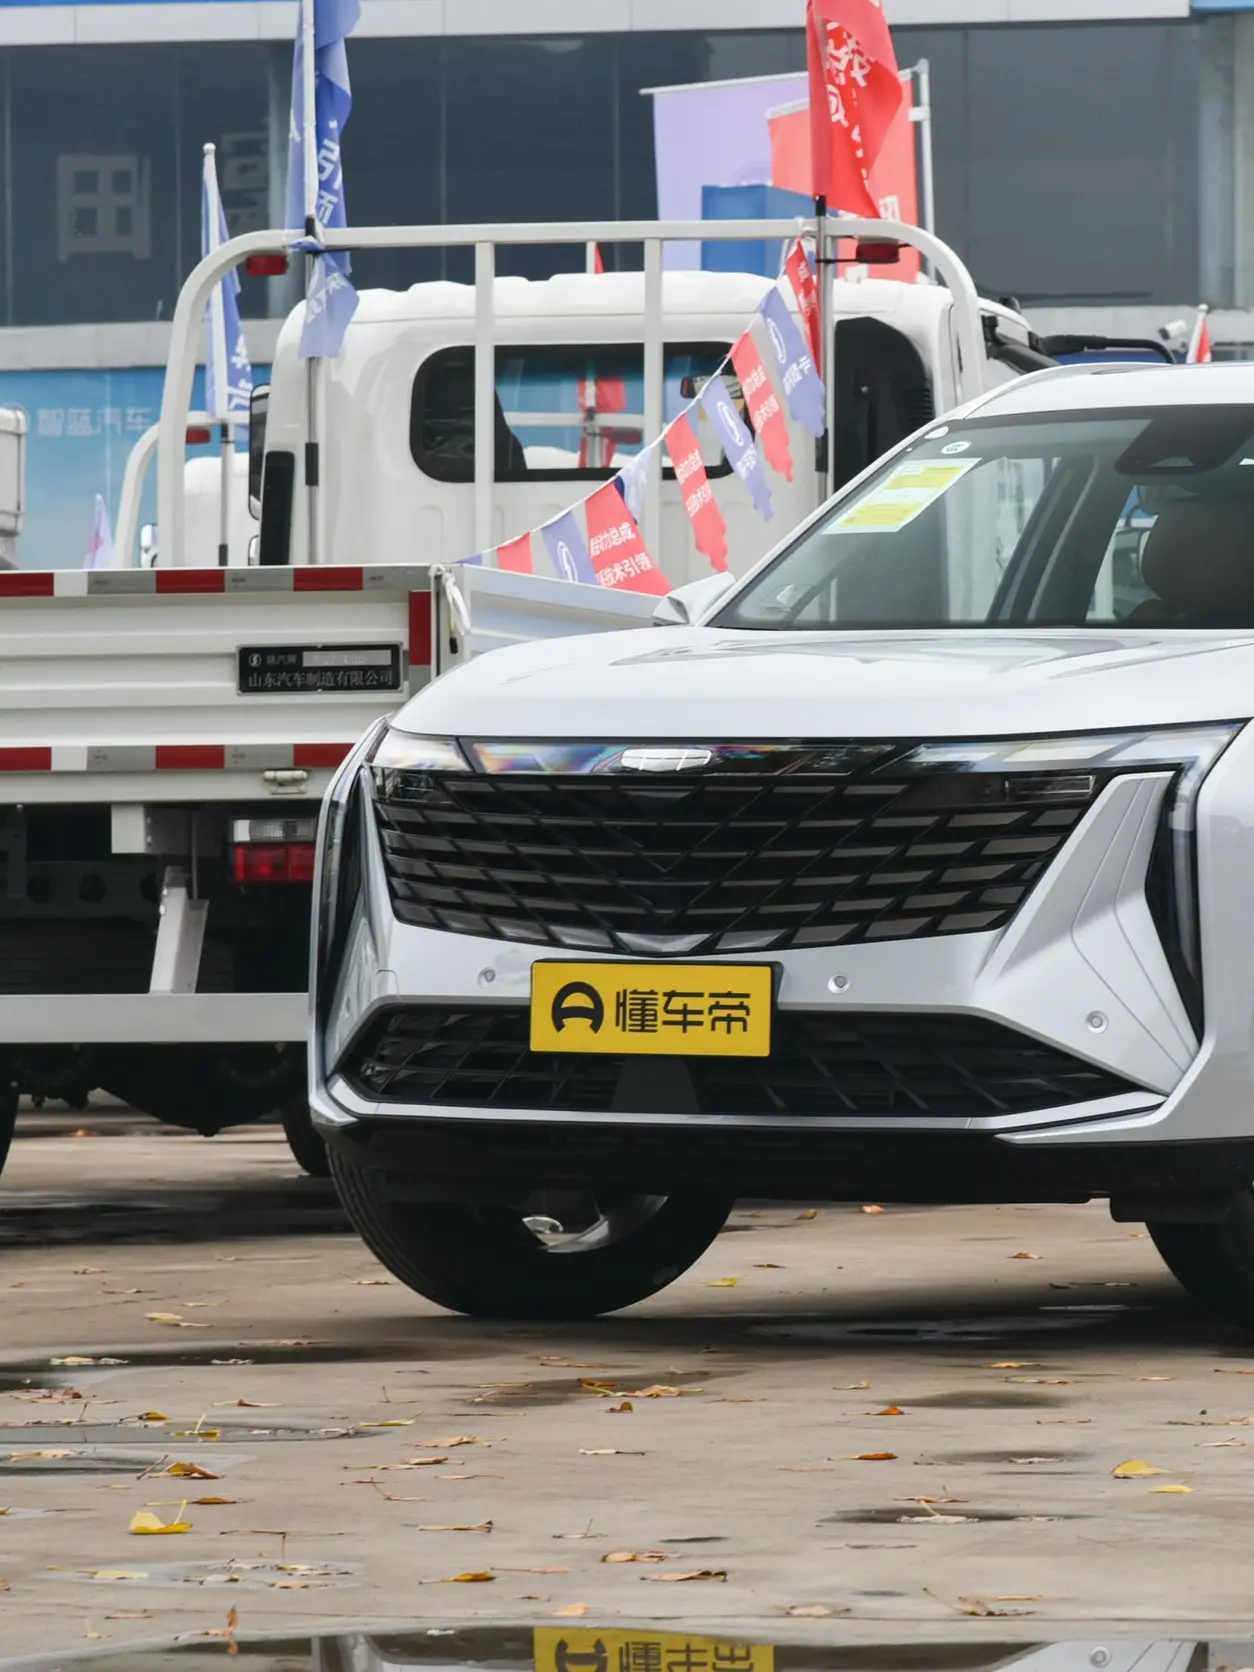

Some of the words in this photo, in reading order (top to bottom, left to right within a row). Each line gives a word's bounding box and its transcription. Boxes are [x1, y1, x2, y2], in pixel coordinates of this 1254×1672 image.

[36, 407, 152, 436] 智蓝汽车
[248, 670, 393, 687] 山东汽车制造有限公司
[615, 989, 751, 1034] 懂车帝
